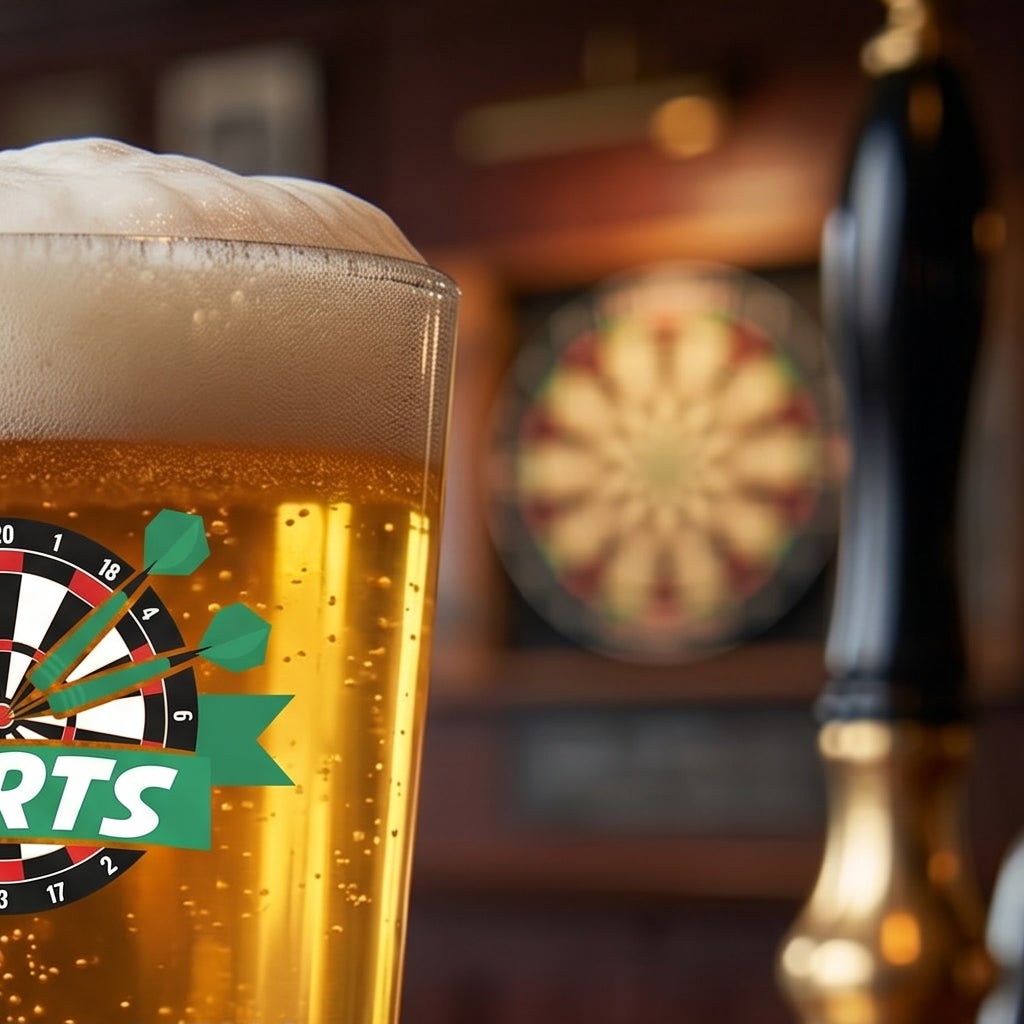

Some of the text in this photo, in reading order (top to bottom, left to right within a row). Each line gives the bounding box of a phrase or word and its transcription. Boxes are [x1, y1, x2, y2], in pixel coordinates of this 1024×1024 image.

[52, 532, 64, 553] 1
[97, 557, 122, 583] 18
[141, 606, 161, 622] 4
[172, 709, 194, 723] 6
[98, 854, 120, 877] 2
[45, 880, 66, 905] 17
